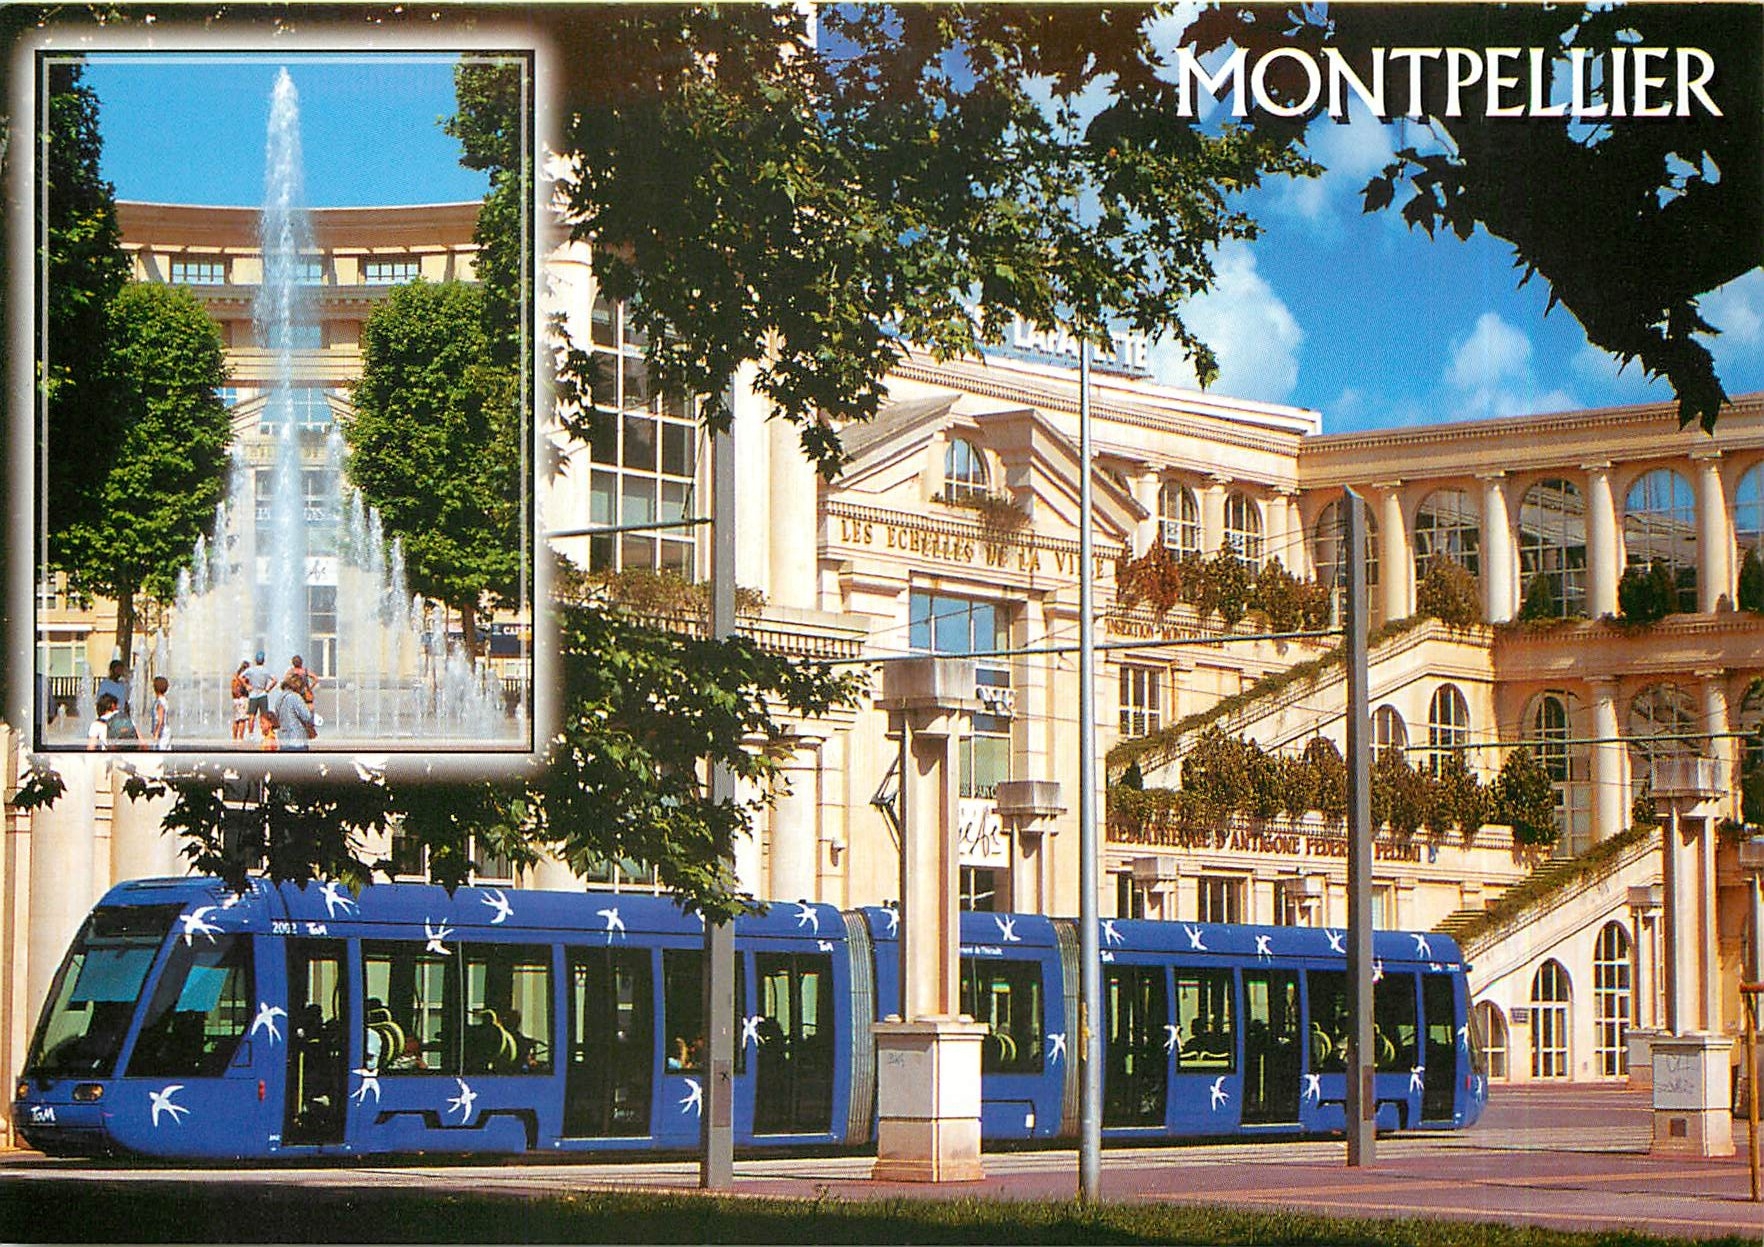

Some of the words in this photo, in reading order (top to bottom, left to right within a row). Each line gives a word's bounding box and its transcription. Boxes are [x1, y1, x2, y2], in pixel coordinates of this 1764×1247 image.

[841, 519, 873, 545] LES
[1054, 550, 1104, 579] VIE
[1304, 836, 1348, 858] FEDER
